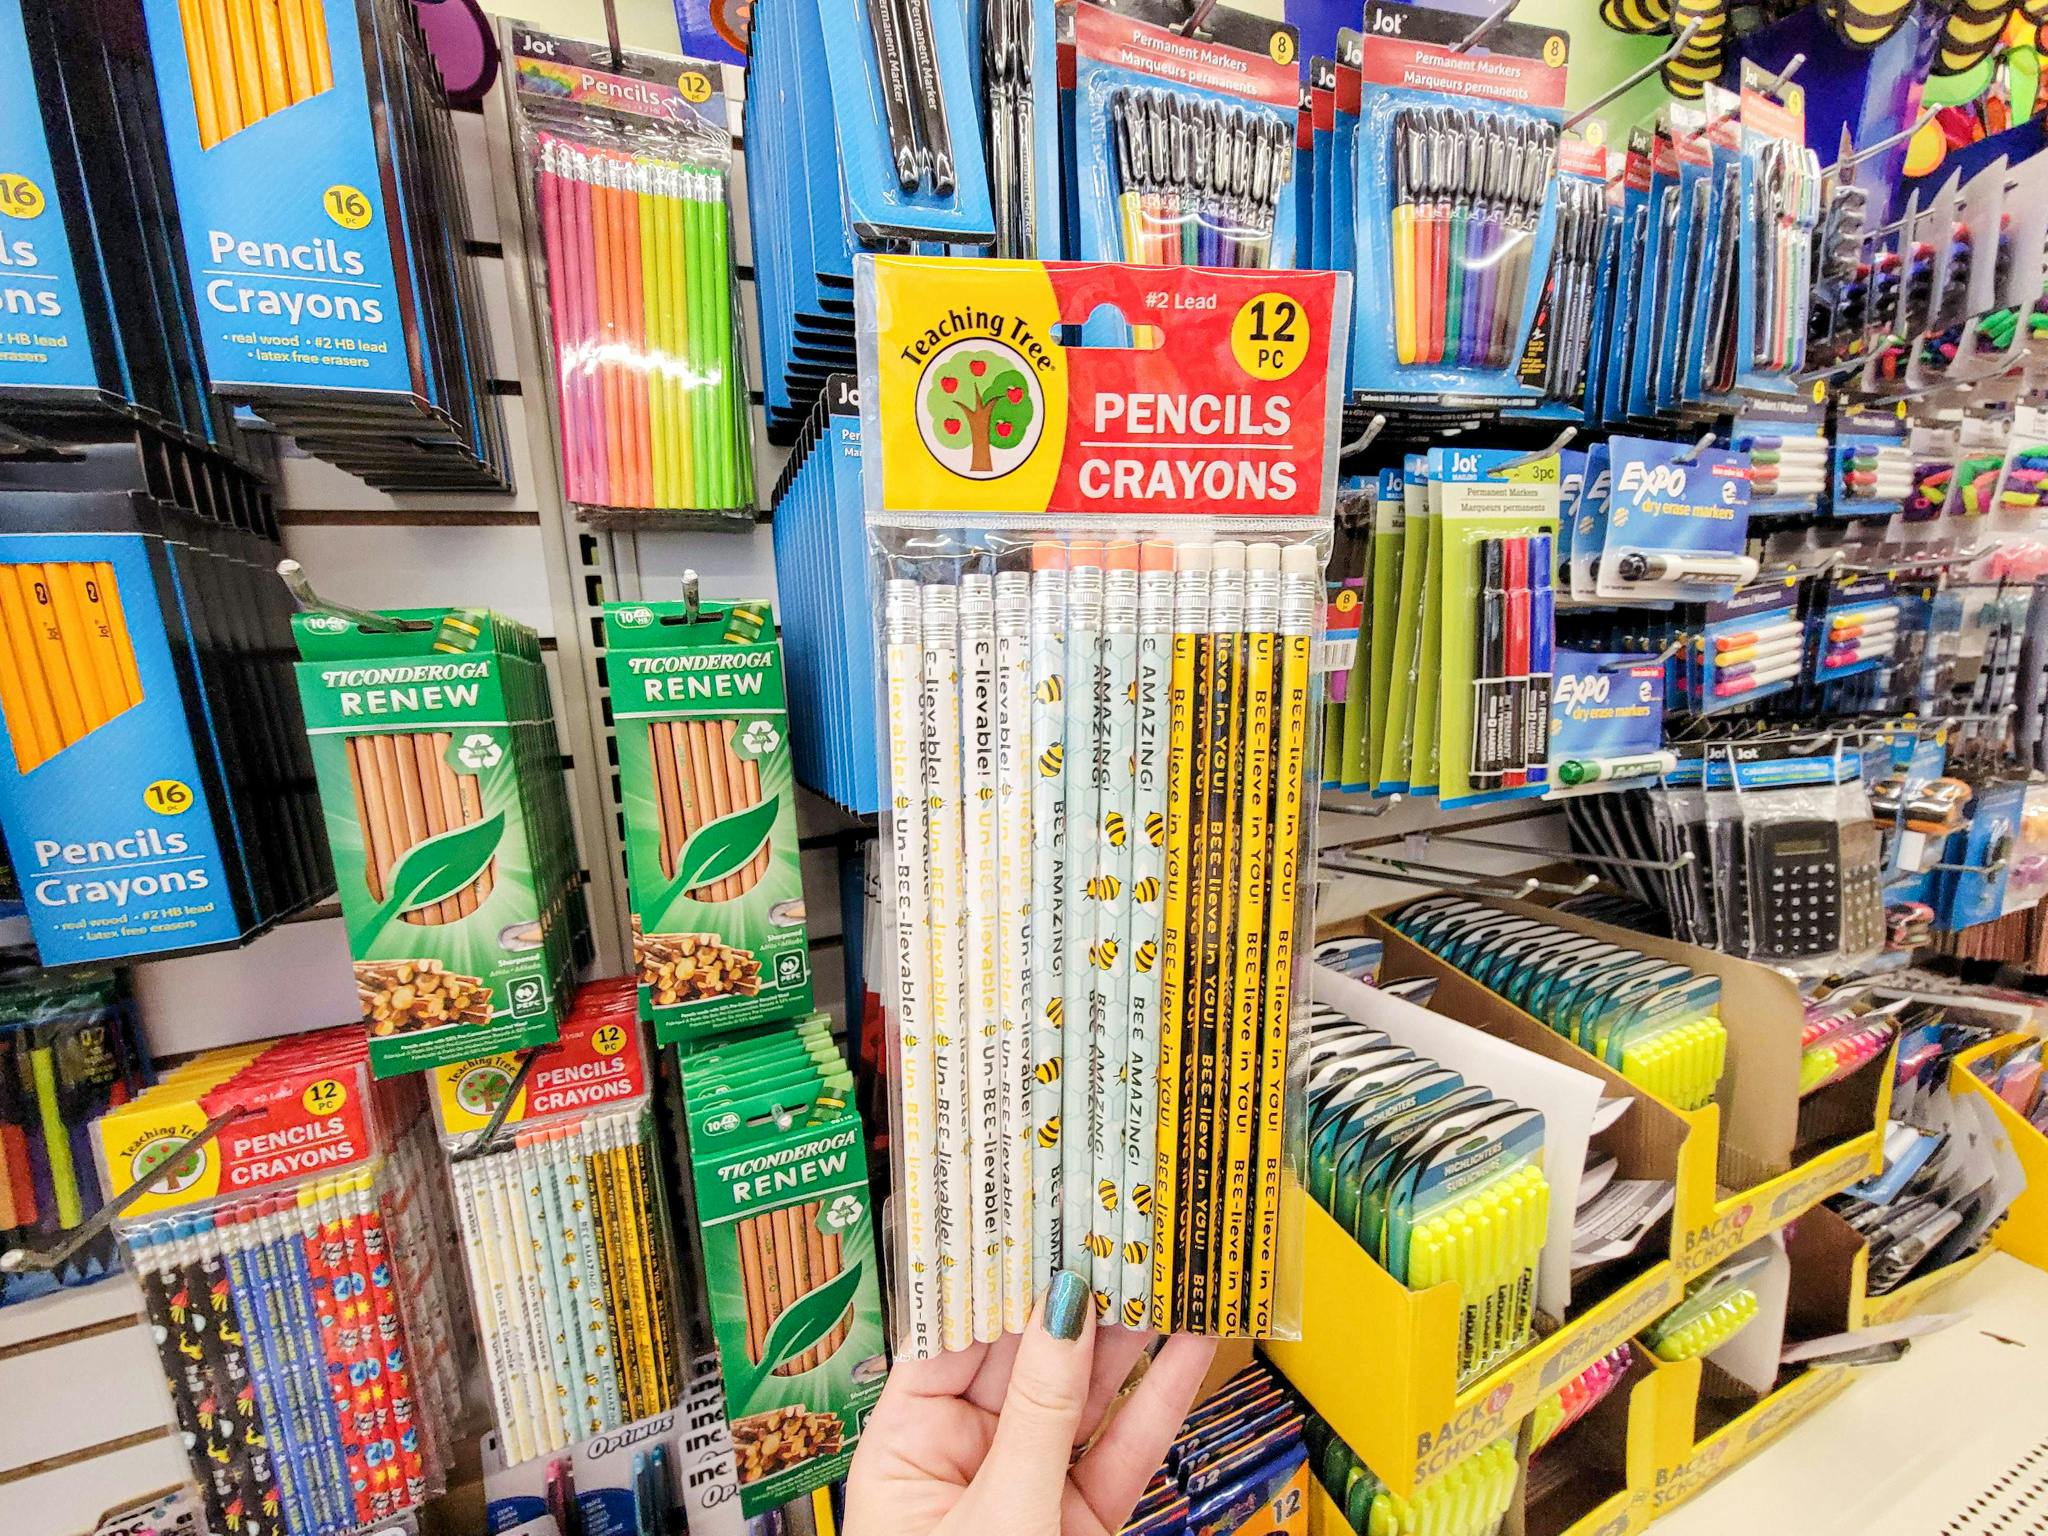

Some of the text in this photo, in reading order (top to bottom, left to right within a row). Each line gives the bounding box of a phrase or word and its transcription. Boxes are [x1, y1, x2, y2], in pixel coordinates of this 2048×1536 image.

[1373, 8, 1402, 34] Jot
[523, 34, 556, 56] Jot
[1132, 30, 1248, 73] Permanent Markers
[1277, 37, 1287, 53] 8
[1415, 51, 1521, 78] Permanent Markers
[1550, 41, 1560, 57] 8
[581, 73, 661, 106] Pencils
[681, 76, 706, 94] 12
[890, 60, 904, 105] Marker
[923, 67, 938, 111] Marker
[1121, 49, 1258, 96] Marqueurs permanents
[1404, 70, 1529, 100] Marqueurs permanents
[329, 190, 366, 217] 16
[208, 230, 366, 275] Pencils
[206, 279, 384, 326] Crayons
[1145, 291, 1217, 311] #2 Lead
[1248, 300, 1297, 343] 12
[232, 332, 257, 345] real
[260, 335, 299, 348] wood
[335, 339, 356, 351] HB
[358, 340, 388, 354] lead
[256, 349, 371, 369] latex free erasers
[900, 305, 1054, 374] Teaching Tree
[1258, 350, 1286, 370] PC
[1093, 393, 1292, 436] PENCILS
[1079, 459, 1297, 501] CRAYONS
[1452, 451, 1477, 473] Jot
[1532, 467, 1555, 483] 3pc
[1467, 487, 1539, 500] Permanent Markers
[1617, 461, 1686, 506] EXPO
[1461, 502, 1546, 516] Marqueurs permanents
[1642, 498, 1735, 520] dry erase markers
[309, 618, 326, 630] 10
[620, 612, 634, 625] 10
[321, 661, 489, 688] TICONDEROGA
[628, 652, 773, 675] TICONDEROGA
[340, 683, 479, 717] RENEW
[644, 672, 763, 703] RENEW
[1553, 674, 1610, 715] EXPO
[1140, 665, 1156, 792] AMAZING!
[1212, 703, 1229, 794] in YOU!
[1737, 747, 1759, 760] Jot
[149, 783, 186, 806] 16
[1165, 689, 1185, 902] BEE-lieve in YOU!
[1249, 690, 1267, 905] BEE-lieve in YOU!
[1281, 689, 1303, 903] BEE-lieve in YOU!
[34, 827, 189, 868] Pencils
[34, 867, 210, 908] Crayons
[1051, 800, 1066, 979] BEE AMAZING!
[896, 818, 916, 1024] Un-BEE-lievable!
[929, 820, 948, 1025] Un-BEE-lievable!
[1203, 820, 1223, 1029] BEE-lieve in YOU!
[598, 1026, 620, 1044] 12
[604, 1043, 617, 1052] PC
[1158, 928, 1177, 1128] BEE-lieve in YOU!
[1236, 932, 1258, 1134] BEE-lieve in YOU!
[1268, 930, 1289, 1132] BEE-lieve in YOU!
[448, 1056, 494, 1083] Teaching
[536, 1057, 626, 1088] PENCILS
[1128, 996, 1145, 1167] BEE AMAZING!
[310, 1081, 338, 1102] 12
[318, 1100, 335, 1111] PC
[533, 1079, 633, 1111] CRAYONS
[707, 1120, 721, 1133] 10
[1000, 1038, 1015, 1226] Un-BEE-lievable!
[1364, 1096, 1417, 1129] HIGHLIGHTERS
[120, 1125, 177, 1159] Teaching
[233, 1117, 345, 1159] PENCILS
[717, 1129, 856, 1182] TICONDEROGA
[935, 1055, 953, 1247] Un-BEE-lievable!
[982, 1044, 999, 1236] Un-BEE-lievable!
[1194, 1053, 1214, 1251] BEE-lieve in YOU!
[231, 1141, 355, 1186] CRAYONS
[732, 1151, 848, 1204] RENEW
[1444, 1142, 1503, 1177] HIGHLIGHTERS
[1154, 1152, 1169, 1283] BEE-lieve in
[1228, 1160, 1245, 1290] BEE-lieve in
[1259, 1158, 1277, 1290] BEE-lieve in
[1417, 1397, 1488, 1459] BACK
[1273, 1489, 1301, 1525] 12
